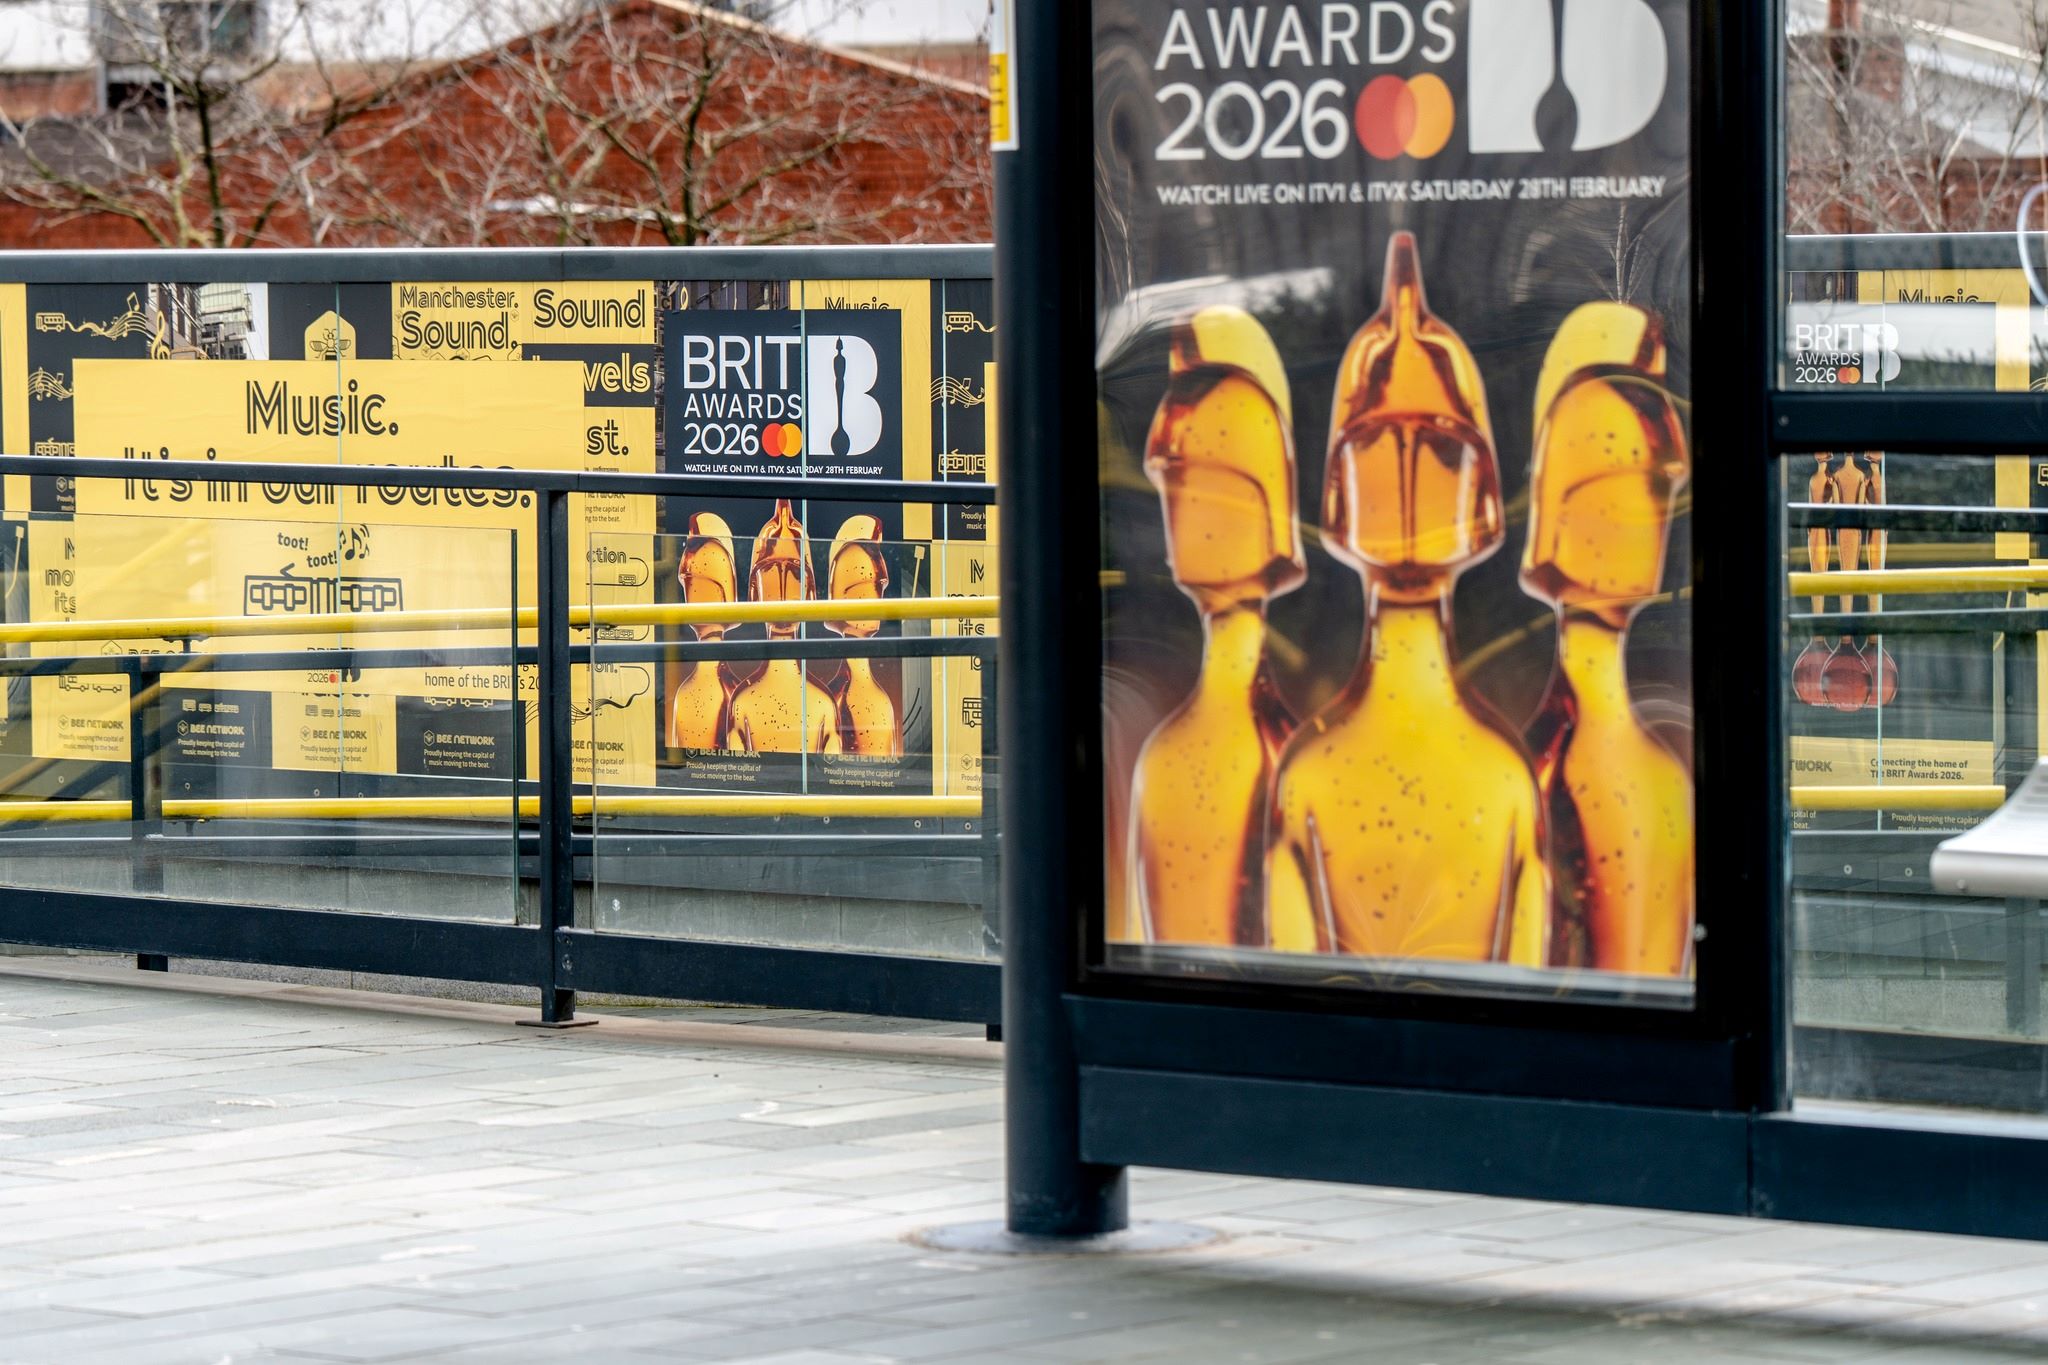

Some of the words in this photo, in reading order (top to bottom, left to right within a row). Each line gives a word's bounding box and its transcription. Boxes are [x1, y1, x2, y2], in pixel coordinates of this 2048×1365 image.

[1154, 0, 1456, 70] AWARDS
[1155, 78, 1349, 160] 2026
[1156, 184, 1228, 205] WATCH
[1234, 183, 1271, 204] LIVE
[1274, 182, 1305, 204] ON
[1308, 182, 1346, 203] ITV1
[1349, 181, 1364, 203] &
[1367, 181, 1408, 202] ITVX
[1410, 178, 1514, 201] SATURDAY
[1518, 178, 1566, 199] 28TH
[1569, 176, 1666, 198] FEBRUARY
[400, 286, 519, 309] Manchester.
[533, 289, 646, 328] Sound
[401, 310, 518, 350] Sound.
[1795, 323, 1860, 351] BRIT
[683, 335, 801, 390] BRIT
[1795, 352, 1861, 365] AWARDS
[584, 352, 651, 393] vels
[1795, 367, 1837, 383] 2026
[246, 379, 399, 436] Music.
[684, 393, 802, 419] AWARDS
[587, 419, 629, 457] st.
[684, 422, 759, 456] 2026
[684, 464, 711, 473] WATCH
[712, 464, 728, 473] LIVE
[730, 464, 742, 473] ON
[744, 465, 759, 474] ITV1
[760, 465, 765, 473] &
[767, 465, 784, 474] ITVX
[825, 466, 844, 475] 28TH
[845, 466, 883, 476] FEBRUARY
[961, 512, 982, 521] Proudly
[277, 532, 309, 551] toot!
[306, 550, 338, 568] toot!
[586, 546, 626, 564] ction
[308, 673, 329, 683] 2026
[425, 672, 455, 687] home
[458, 673, 468, 687] of
[472, 674, 490, 688] the
[71, 718, 85, 728] BEE
[190, 724, 205, 734] BEE
[313, 729, 328, 739] BEE
[329, 730, 367, 740] NEWORK
[436, 733, 452, 744] BEE
[686, 761, 705, 770] Proudly
[707, 763, 727, 772] keeping
[738, 764, 754, 773] capital
[755, 764, 761, 772] of
[1917, 759, 1932, 768] the
[1934, 759, 1957, 768] home
[1959, 760, 1968, 768] of
[707, 773, 726, 782] moving
[824, 767, 844, 777] Proudly
[845, 769, 865, 778] keeping
[866, 769, 875, 777] the
[876, 770, 893, 779] capital
[894, 770, 900, 778] of
[1886, 770, 1905, 778] BRIT
[1908, 770, 1939, 779] Awards
[1940, 771, 1964, 780] 2026.
[1891, 812, 1915, 824] Proudly
[1917, 814, 1943, 825] keeping
[1944, 815, 1955, 824] the
[1956, 815, 1978, 825] capital
